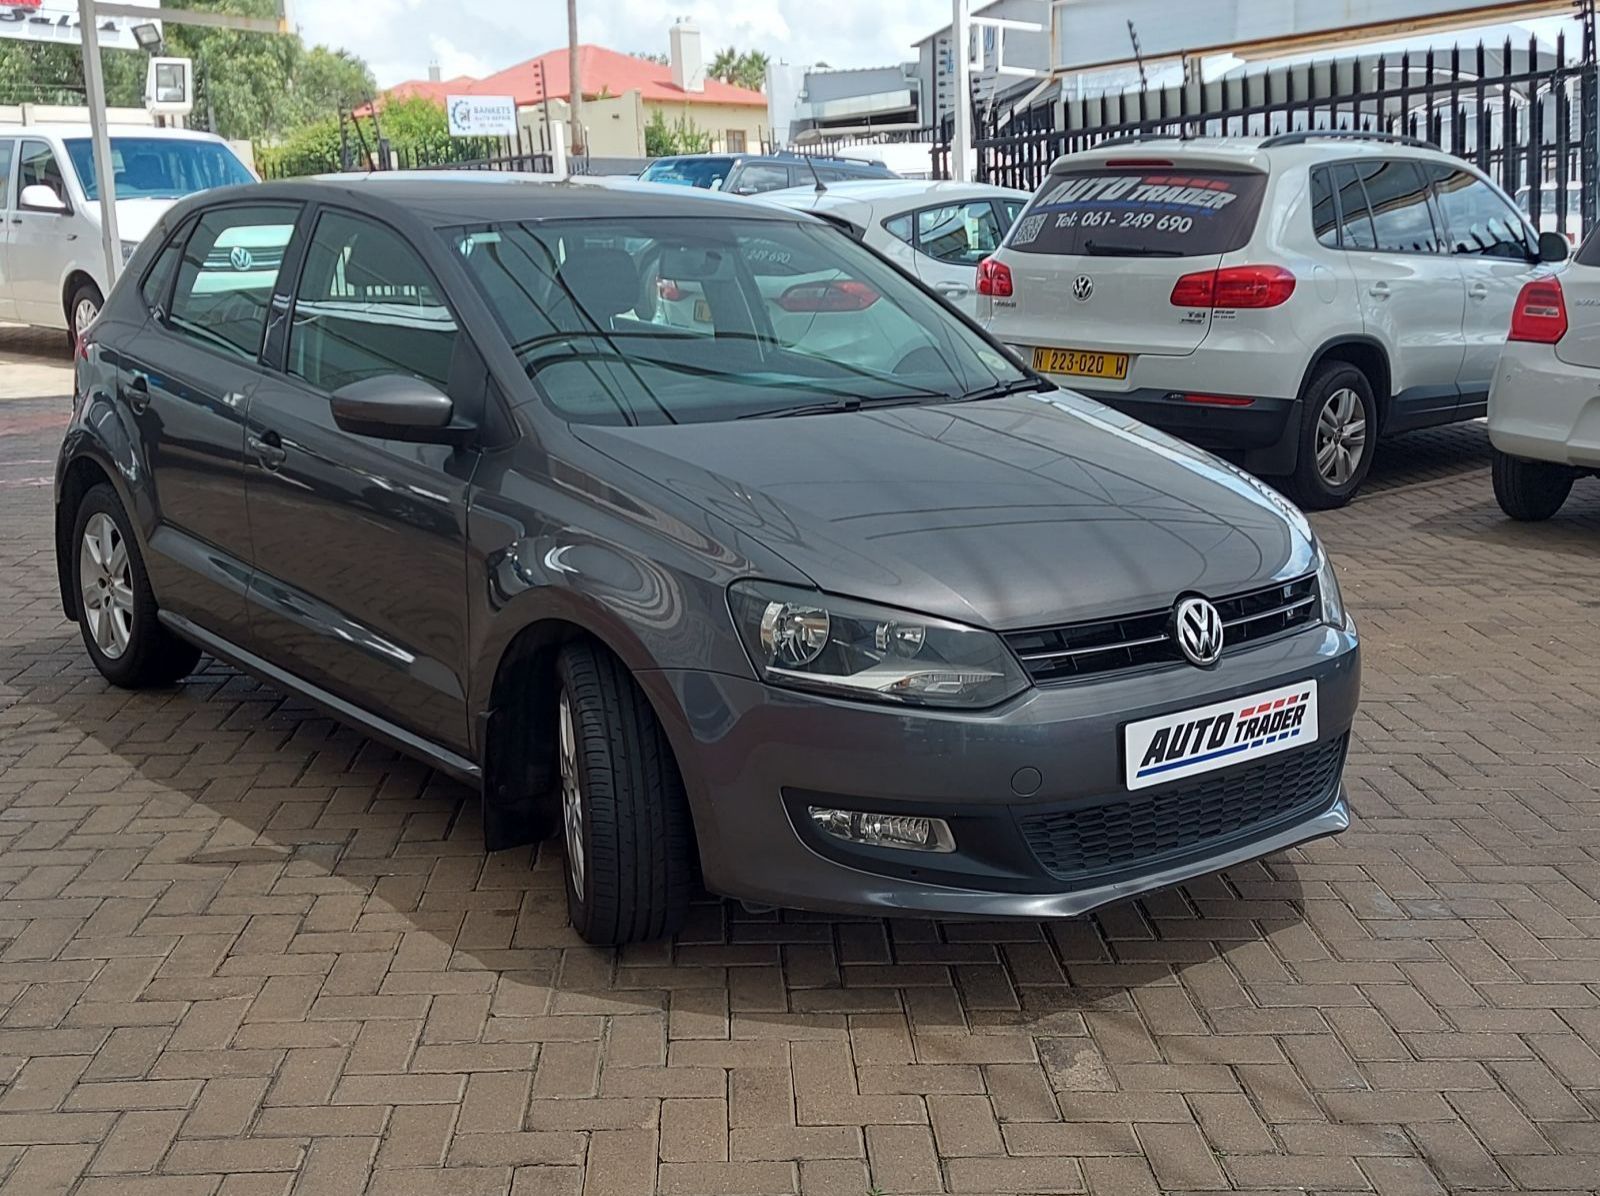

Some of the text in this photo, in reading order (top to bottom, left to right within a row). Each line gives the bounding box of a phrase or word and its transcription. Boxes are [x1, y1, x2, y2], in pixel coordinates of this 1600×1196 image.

[1036, 176, 1237, 210] AUTO TRADER
[1055, 211, 1193, 233] Tel: 061- 249 690
[1036, 351, 1125, 375] N 223-020 W
[1140, 703, 1307, 768] AUTO TRADER
